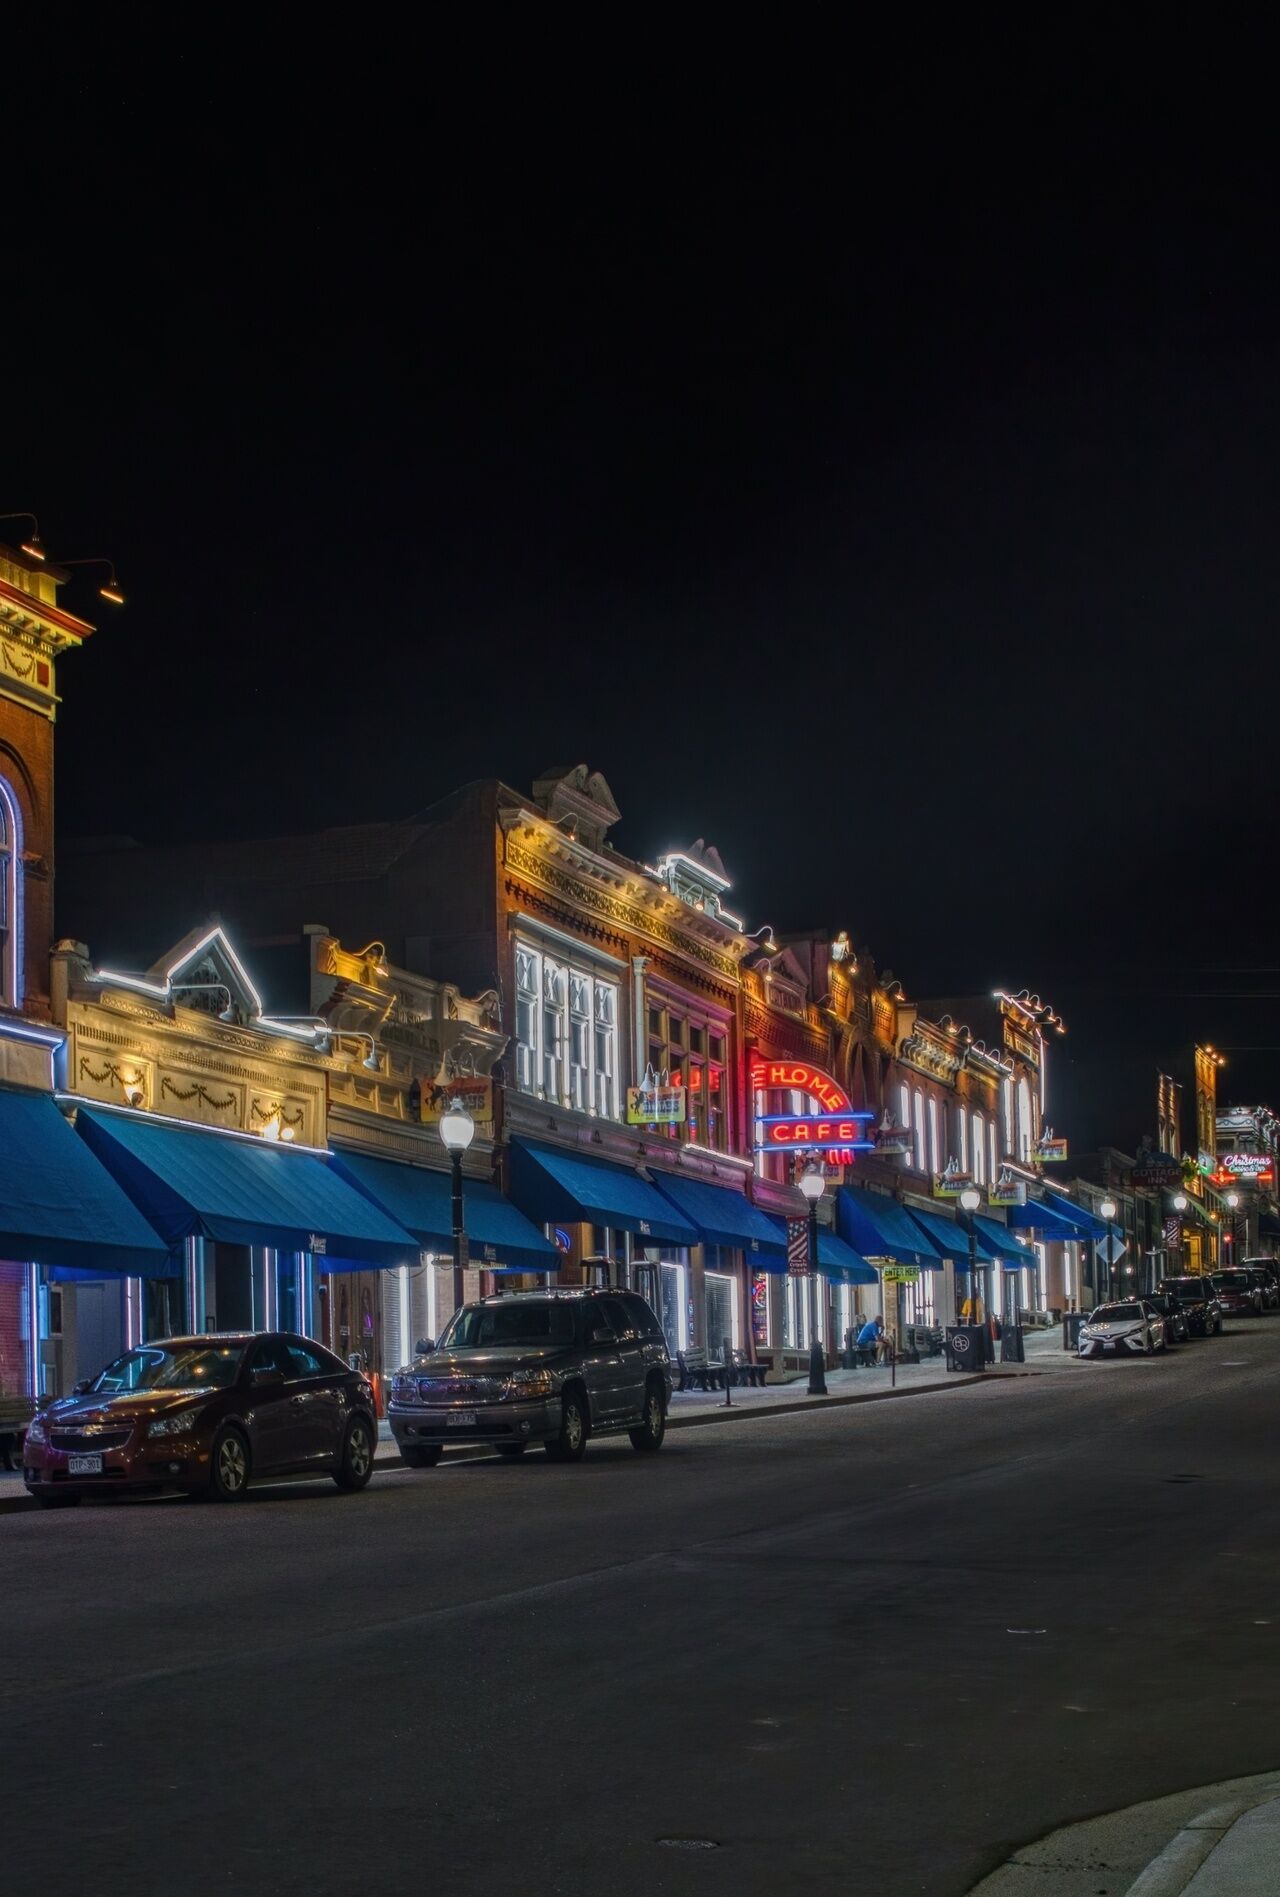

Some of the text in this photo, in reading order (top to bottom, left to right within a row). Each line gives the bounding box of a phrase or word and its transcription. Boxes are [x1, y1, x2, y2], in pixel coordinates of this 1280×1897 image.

[771, 1067, 843, 1112] HOME
[773, 1123, 854, 1141] CAFE
[1132, 1168, 1182, 1178] COTTAGE
[1148, 1176, 1168, 1184] INN
[884, 1267, 904, 1276] ENTER
